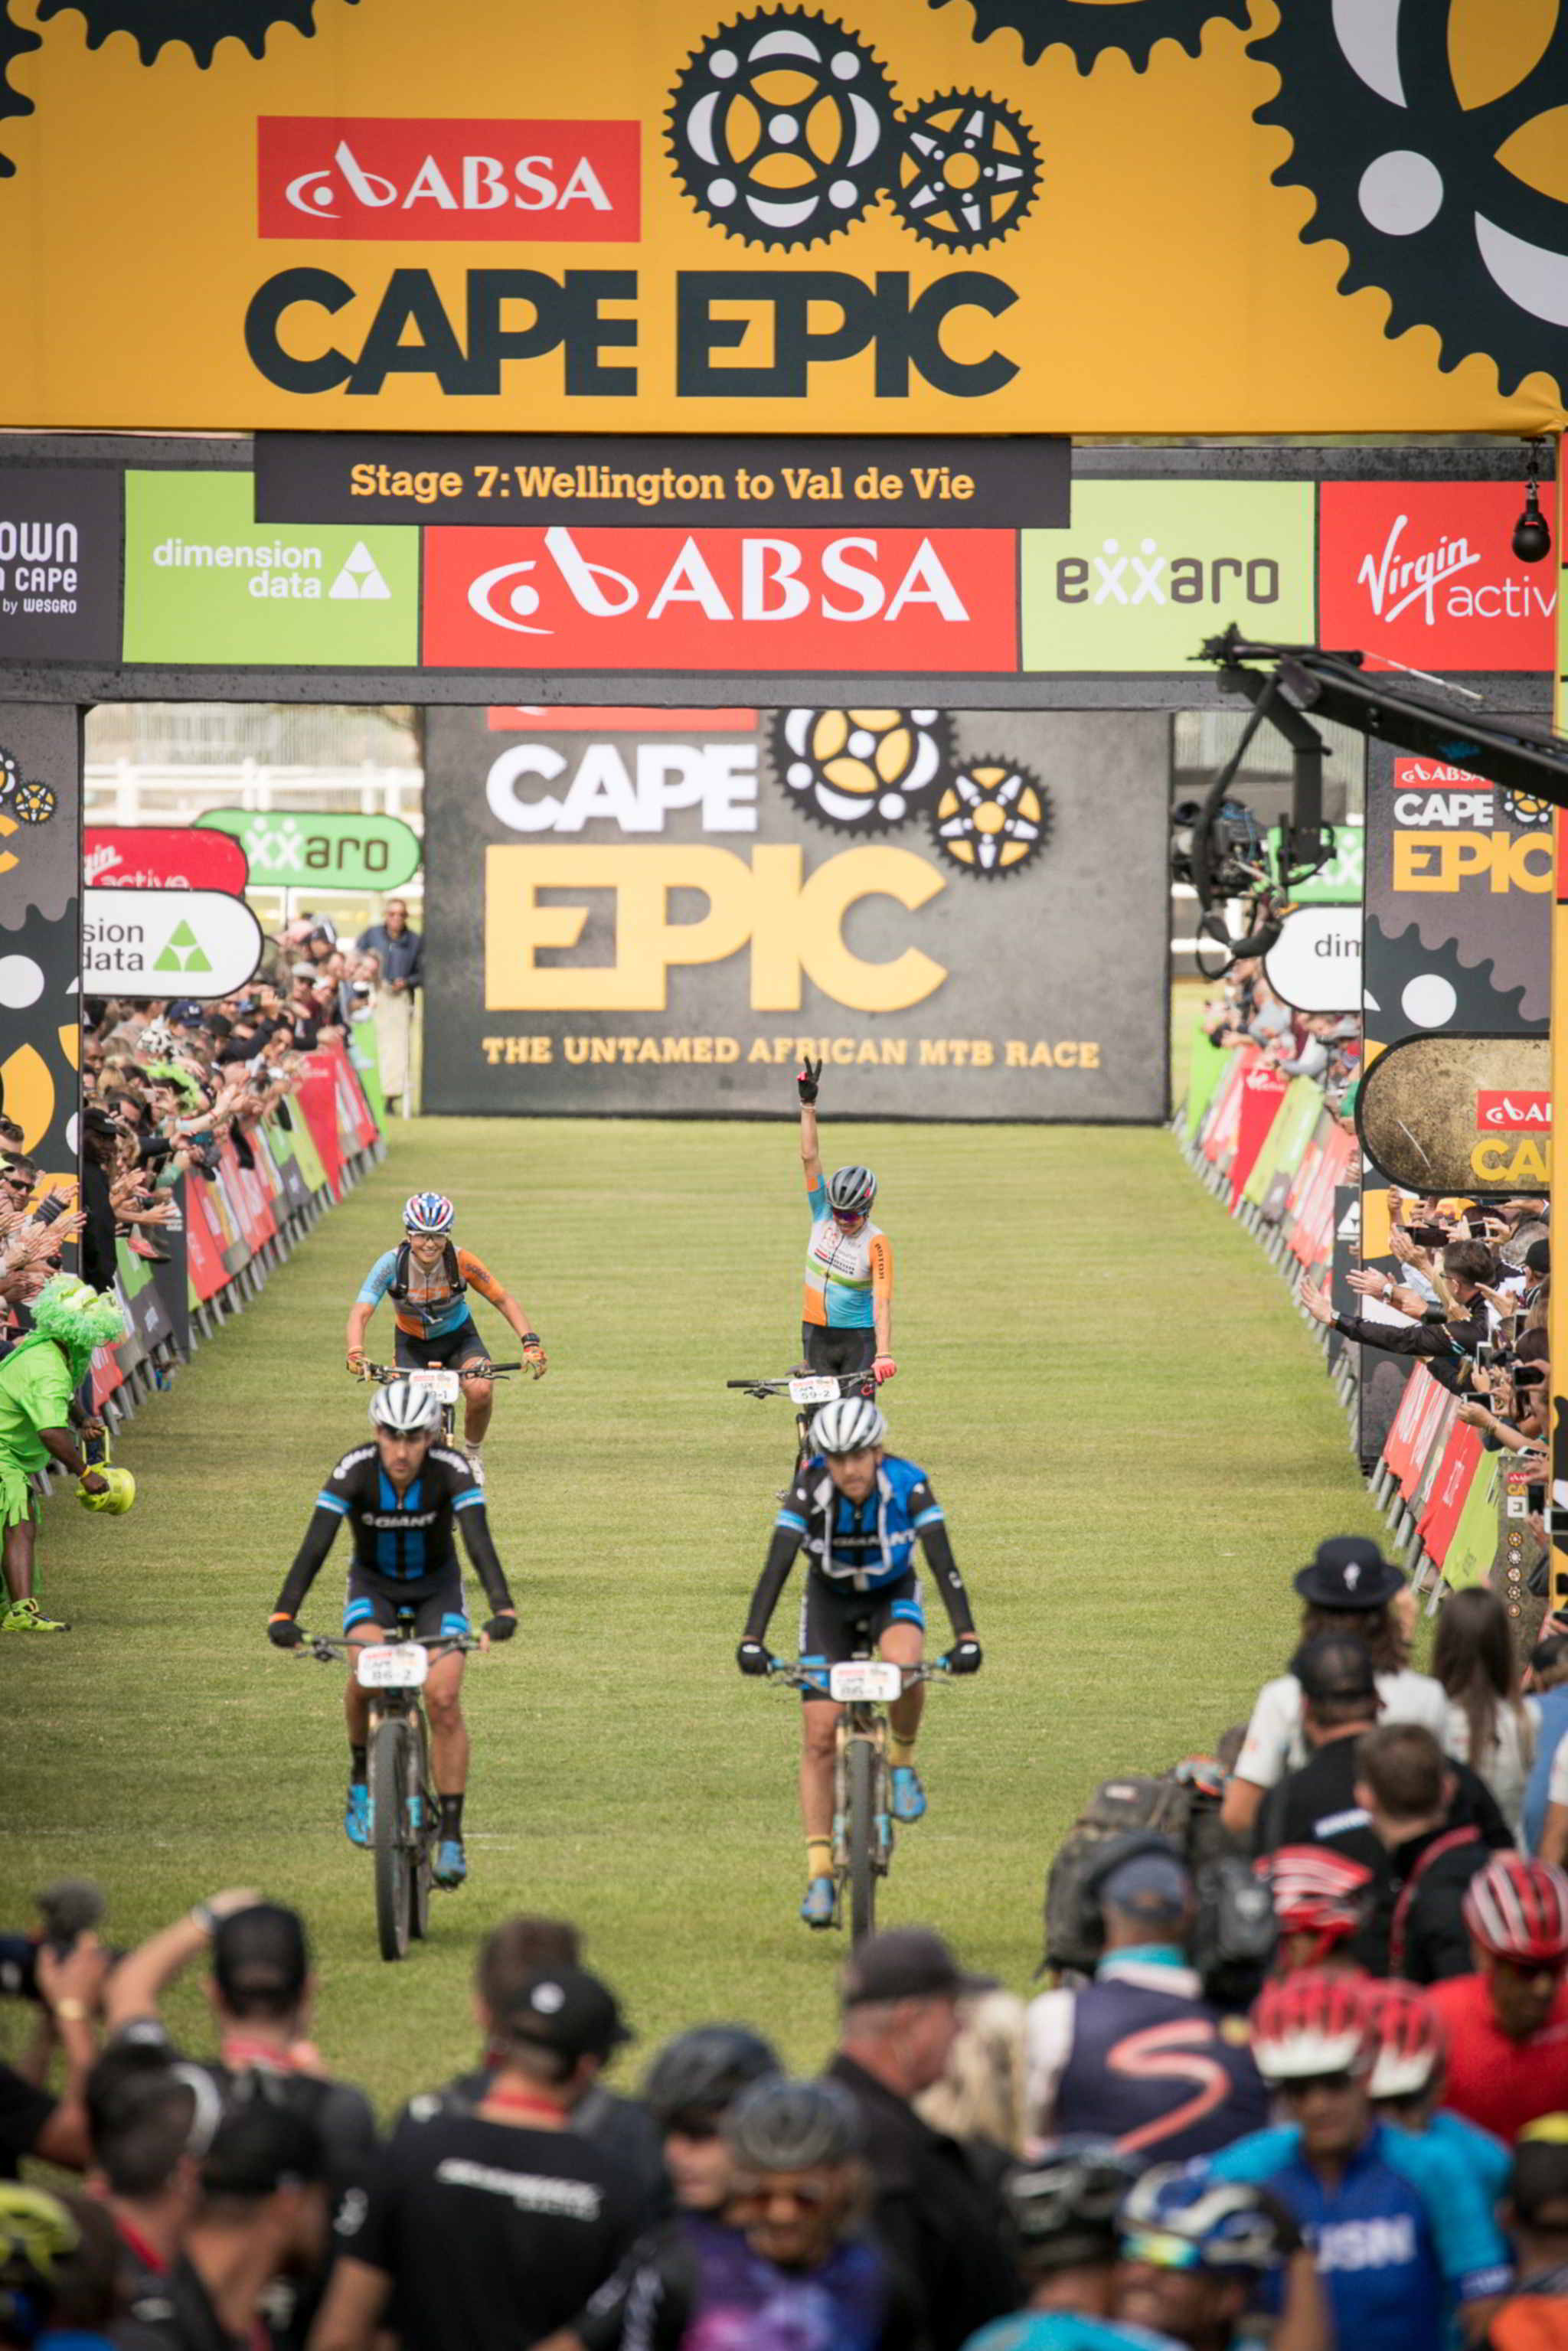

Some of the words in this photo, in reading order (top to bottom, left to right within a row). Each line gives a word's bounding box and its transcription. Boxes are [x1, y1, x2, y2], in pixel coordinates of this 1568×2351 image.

[402, 154, 614, 211] ABSA
[244, 266, 638, 397] CAPE
[676, 269, 1021, 398] EPIC
[350, 463, 463, 504] Stage
[735, 468, 775, 500] to
[781, 466, 844, 500] Val
[854, 466, 903, 500] de
[910, 466, 975, 500] Vie
[152, 537, 322, 570] dimension
[645, 534, 971, 622] ABSA
[1056, 538, 1280, 605] exxaro
[1357, 514, 1482, 626] Virgin
[2, 598, 18, 616] by
[247, 569, 322, 599] data
[485, 743, 759, 833] CAPE
[1393, 793, 1494, 826] CAPE
[485, 844, 949, 1013] EPIC
[482, 1036, 554, 1064] THE
[564, 1036, 740, 1065] UNTAMED
[748, 1037, 908, 1066] AFRICAN
[919, 1038, 995, 1068] MTB
[1004, 1039, 1101, 1069] RACE
